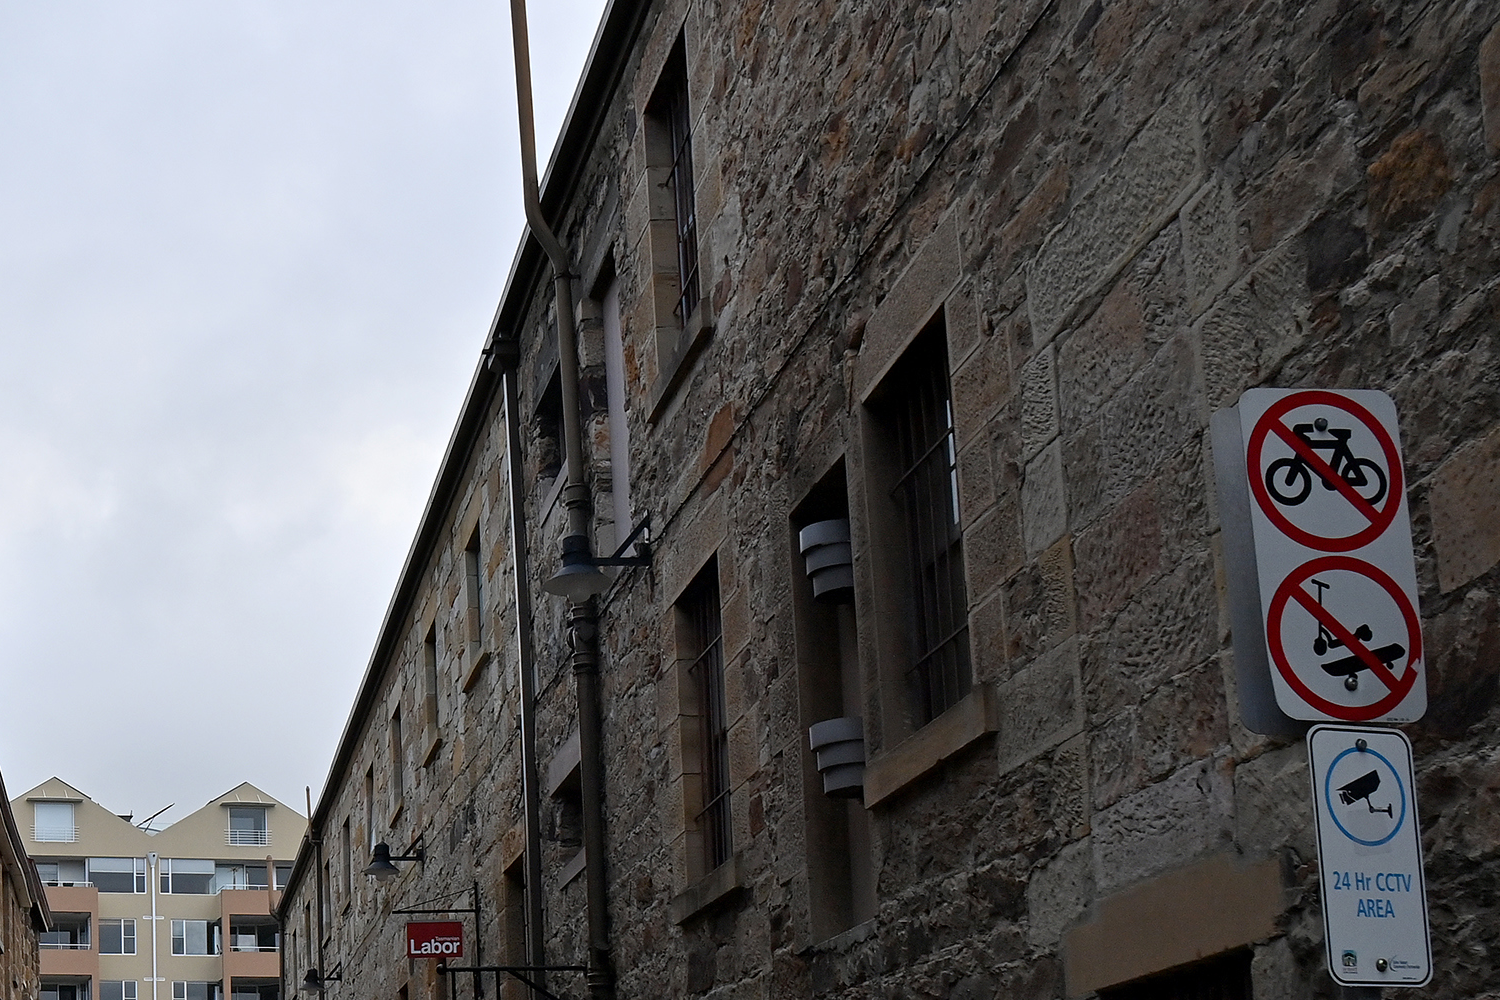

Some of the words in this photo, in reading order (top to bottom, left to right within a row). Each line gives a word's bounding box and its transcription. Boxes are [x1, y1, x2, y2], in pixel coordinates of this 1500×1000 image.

[1333, 871, 1351, 890] 24
[1355, 872, 1371, 891] Hr
[1376, 873, 1411, 892] CCTV
[1357, 899, 1395, 918] AREA
[410, 939, 460, 954] Labor
